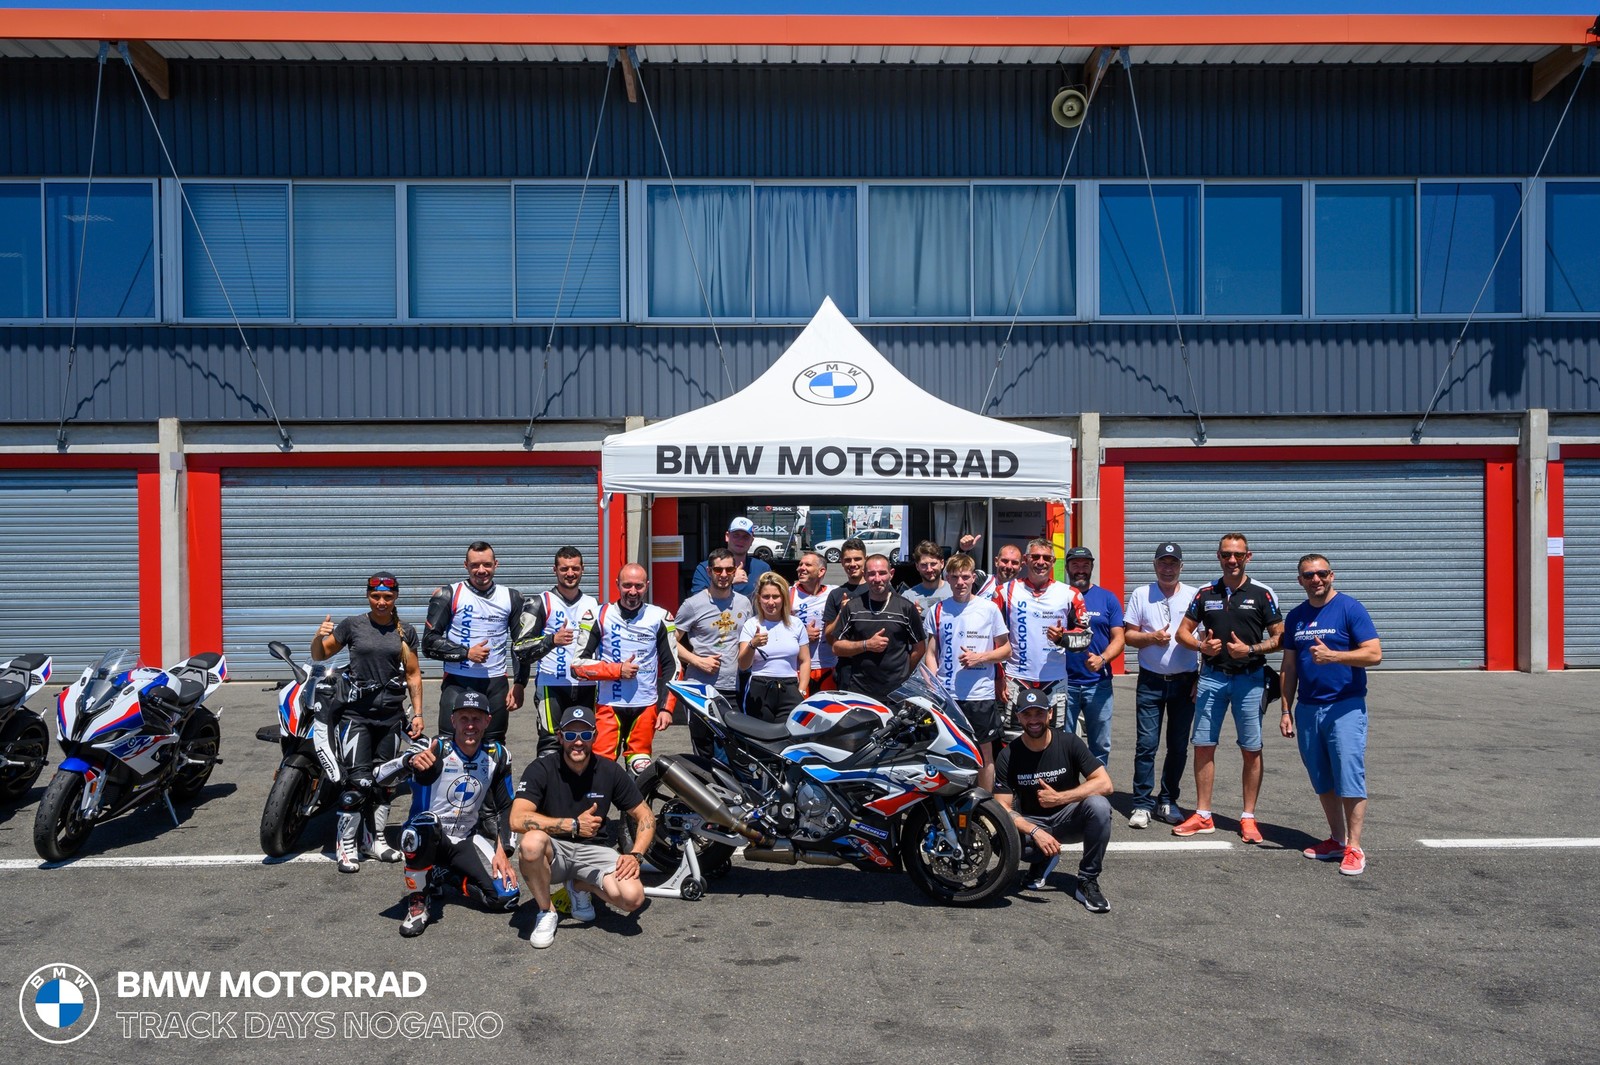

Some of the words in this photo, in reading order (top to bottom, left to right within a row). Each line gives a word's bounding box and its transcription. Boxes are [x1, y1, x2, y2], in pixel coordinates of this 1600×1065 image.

[804, 364, 861, 379] BMW
[656, 445, 763, 475] BMW
[778, 446, 1019, 479] MOTORRAD
[1017, 600, 1027, 673] TRACKDAYS
[1033, 767, 1067, 779] MOTORRAD
